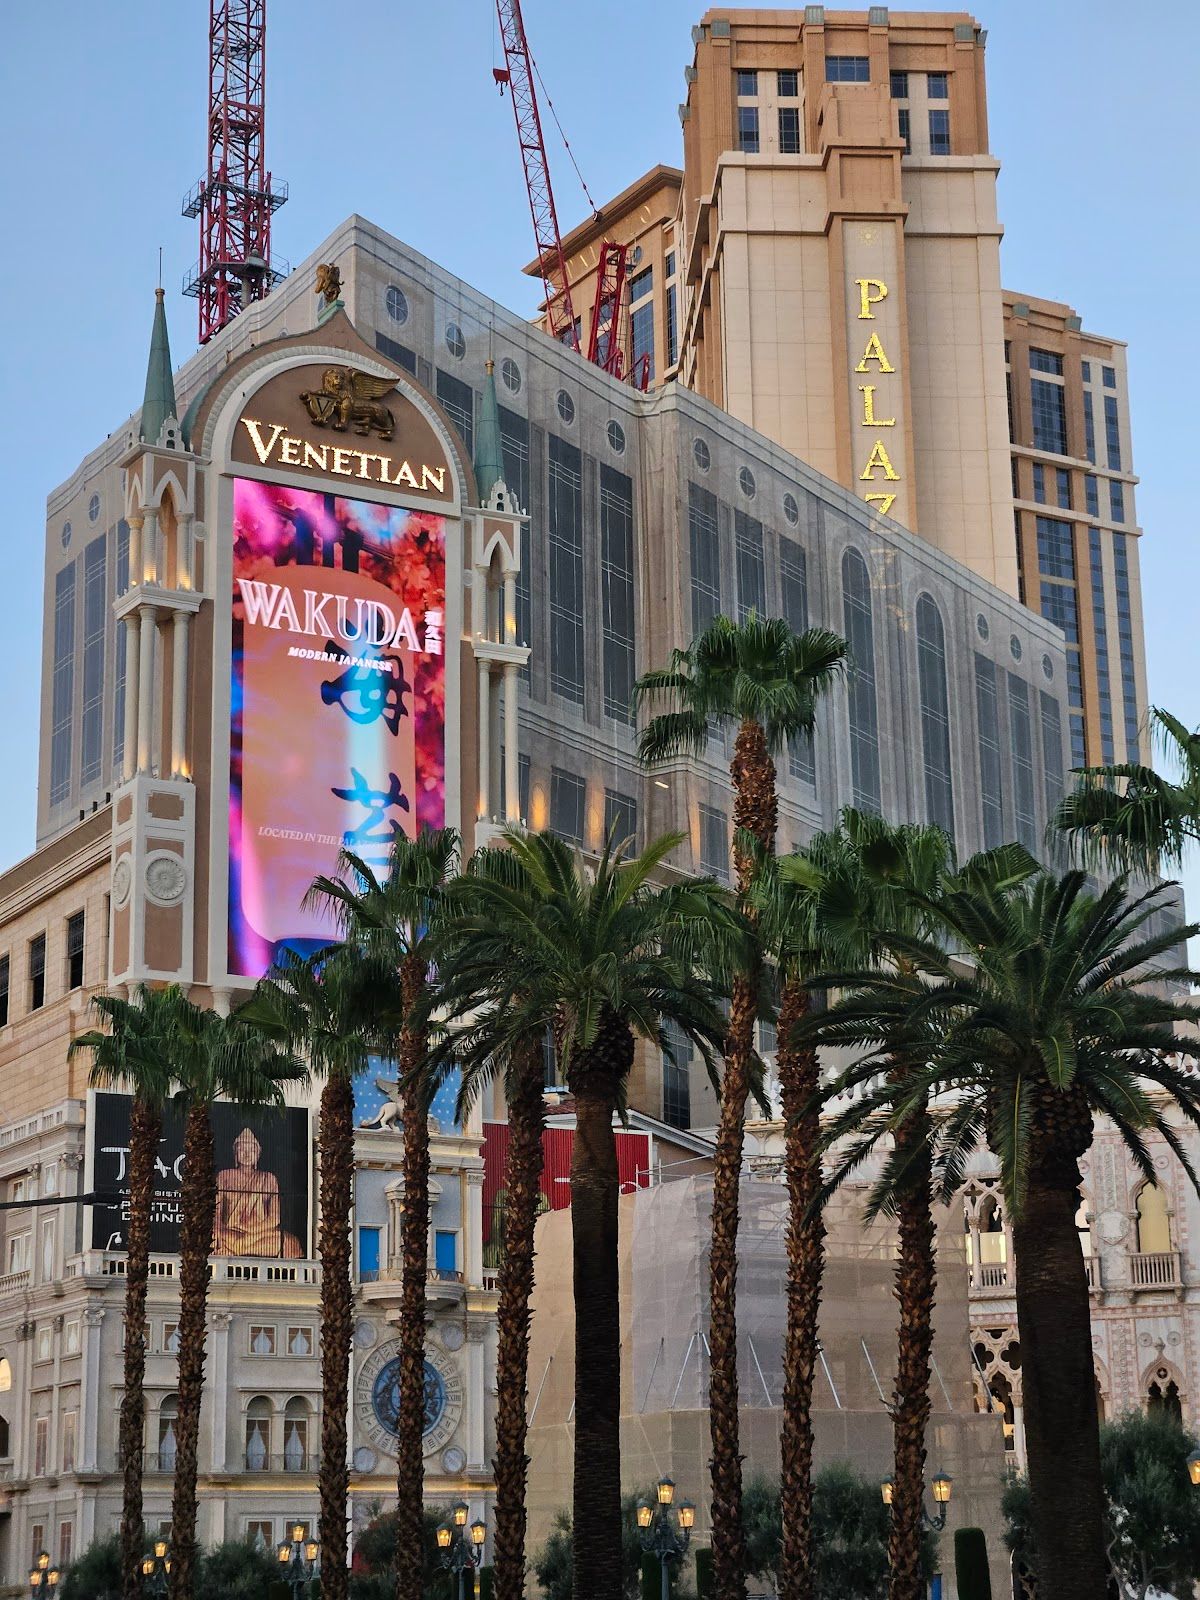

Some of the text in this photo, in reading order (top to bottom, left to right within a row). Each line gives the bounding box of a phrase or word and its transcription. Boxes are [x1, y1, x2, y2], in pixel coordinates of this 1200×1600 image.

[316, 397, 331, 415] V
[240, 418, 446, 493] VENETIAN
[235, 577, 424, 653] WAKUDA
[287, 646, 393, 672] MODERN JAPANESE
[258, 826, 304, 841] LOCATED
[304, 832, 315, 842] IN
[315, 834, 337, 846] THE
